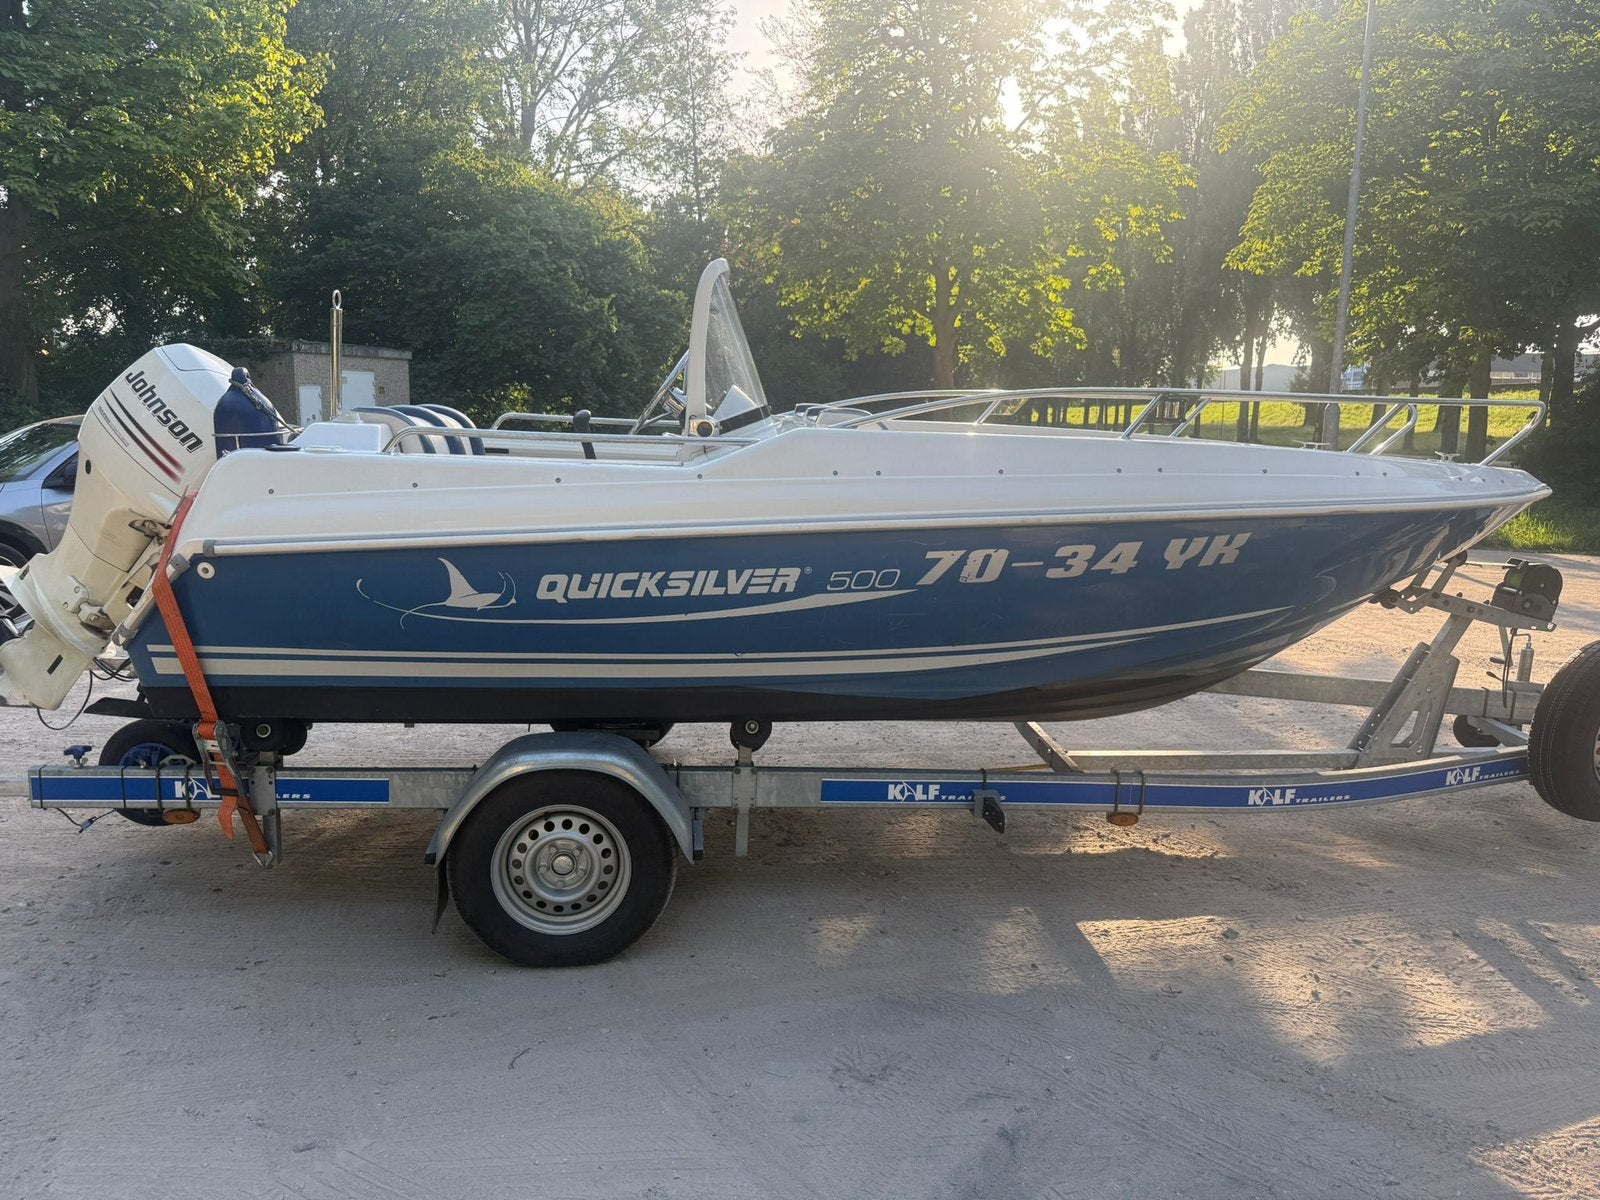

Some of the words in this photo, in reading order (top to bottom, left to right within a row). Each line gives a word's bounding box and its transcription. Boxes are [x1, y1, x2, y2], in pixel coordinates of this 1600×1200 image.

[125, 370, 204, 453] Johnson
[1164, 532, 1253, 570] YK
[826, 568, 901, 591] 500
[1296, 794, 1351, 803] TRAILERS
